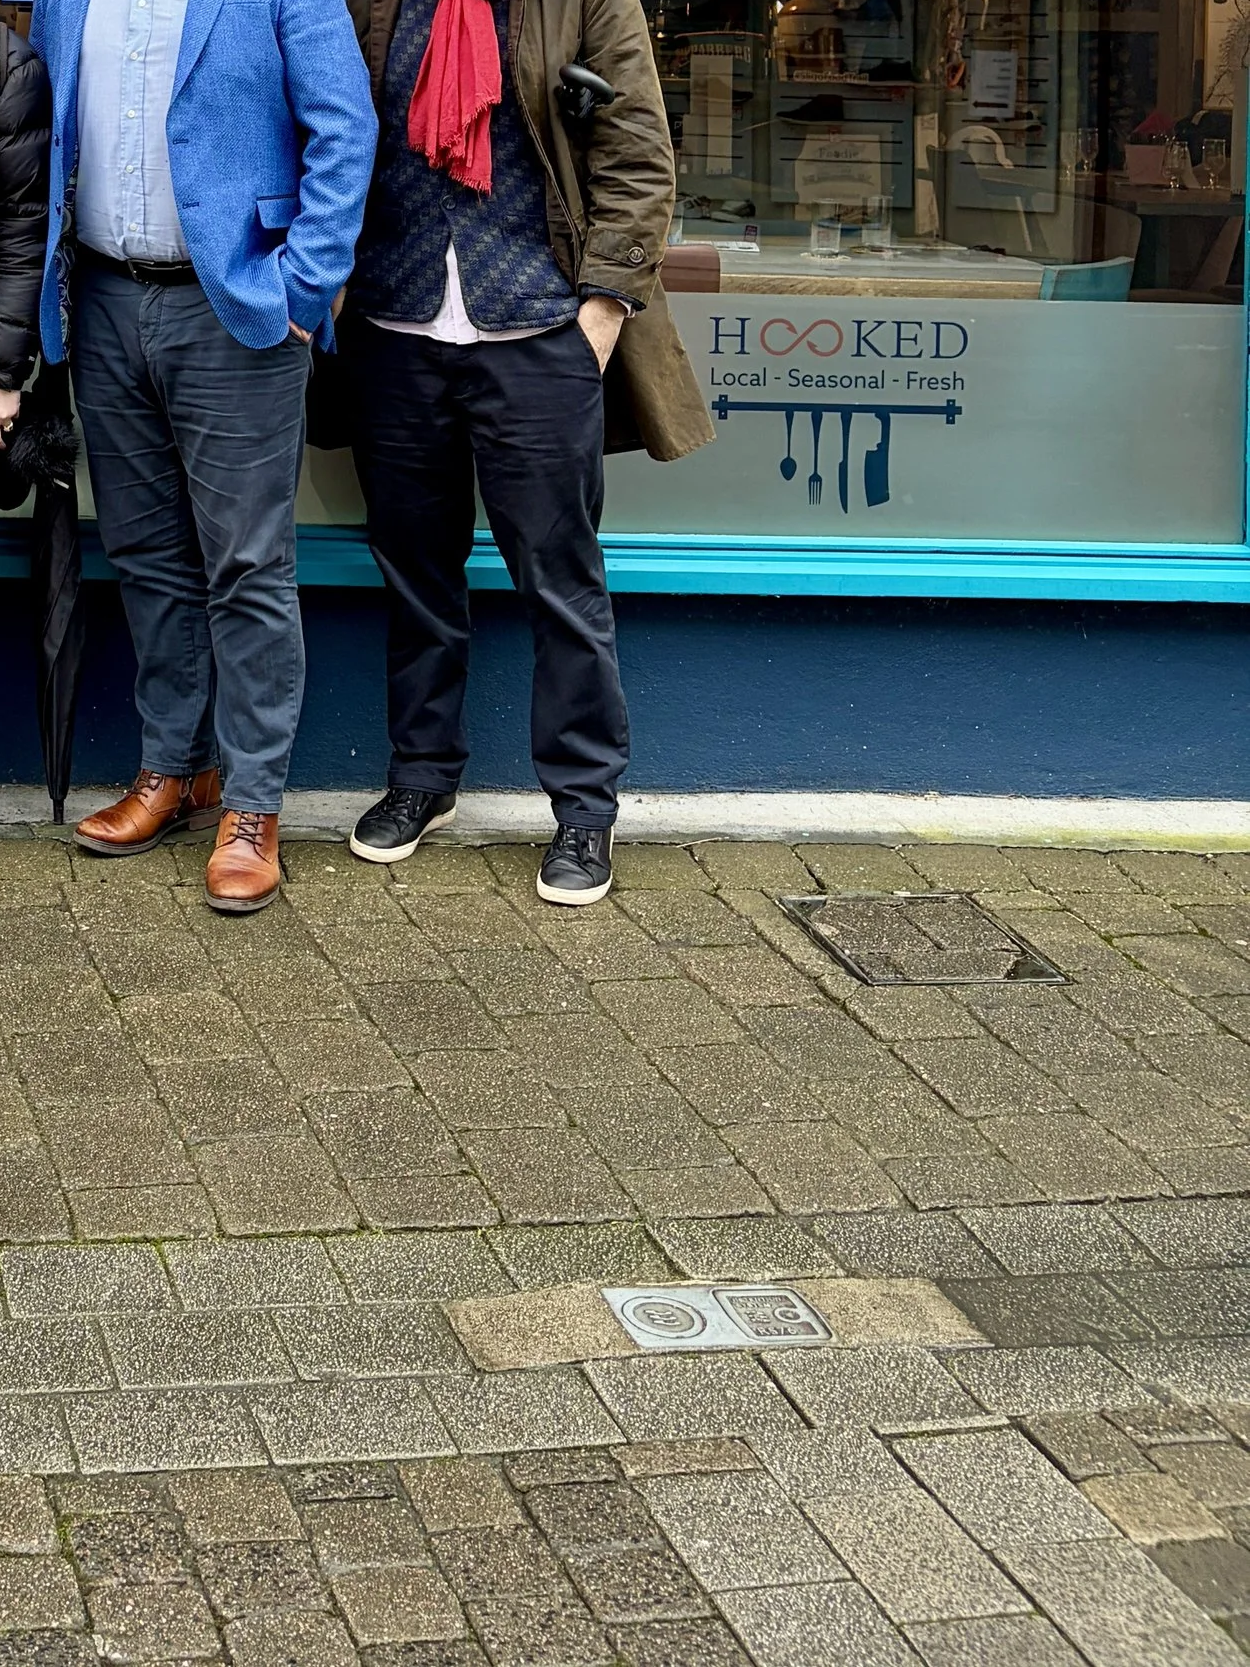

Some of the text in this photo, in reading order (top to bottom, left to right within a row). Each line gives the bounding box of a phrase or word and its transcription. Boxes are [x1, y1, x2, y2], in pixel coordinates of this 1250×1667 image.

[708, 316, 969, 360] HOOKED
[710, 366, 768, 388] Local
[787, 366, 885, 391] Seasonal
[906, 369, 965, 392] Fresh
